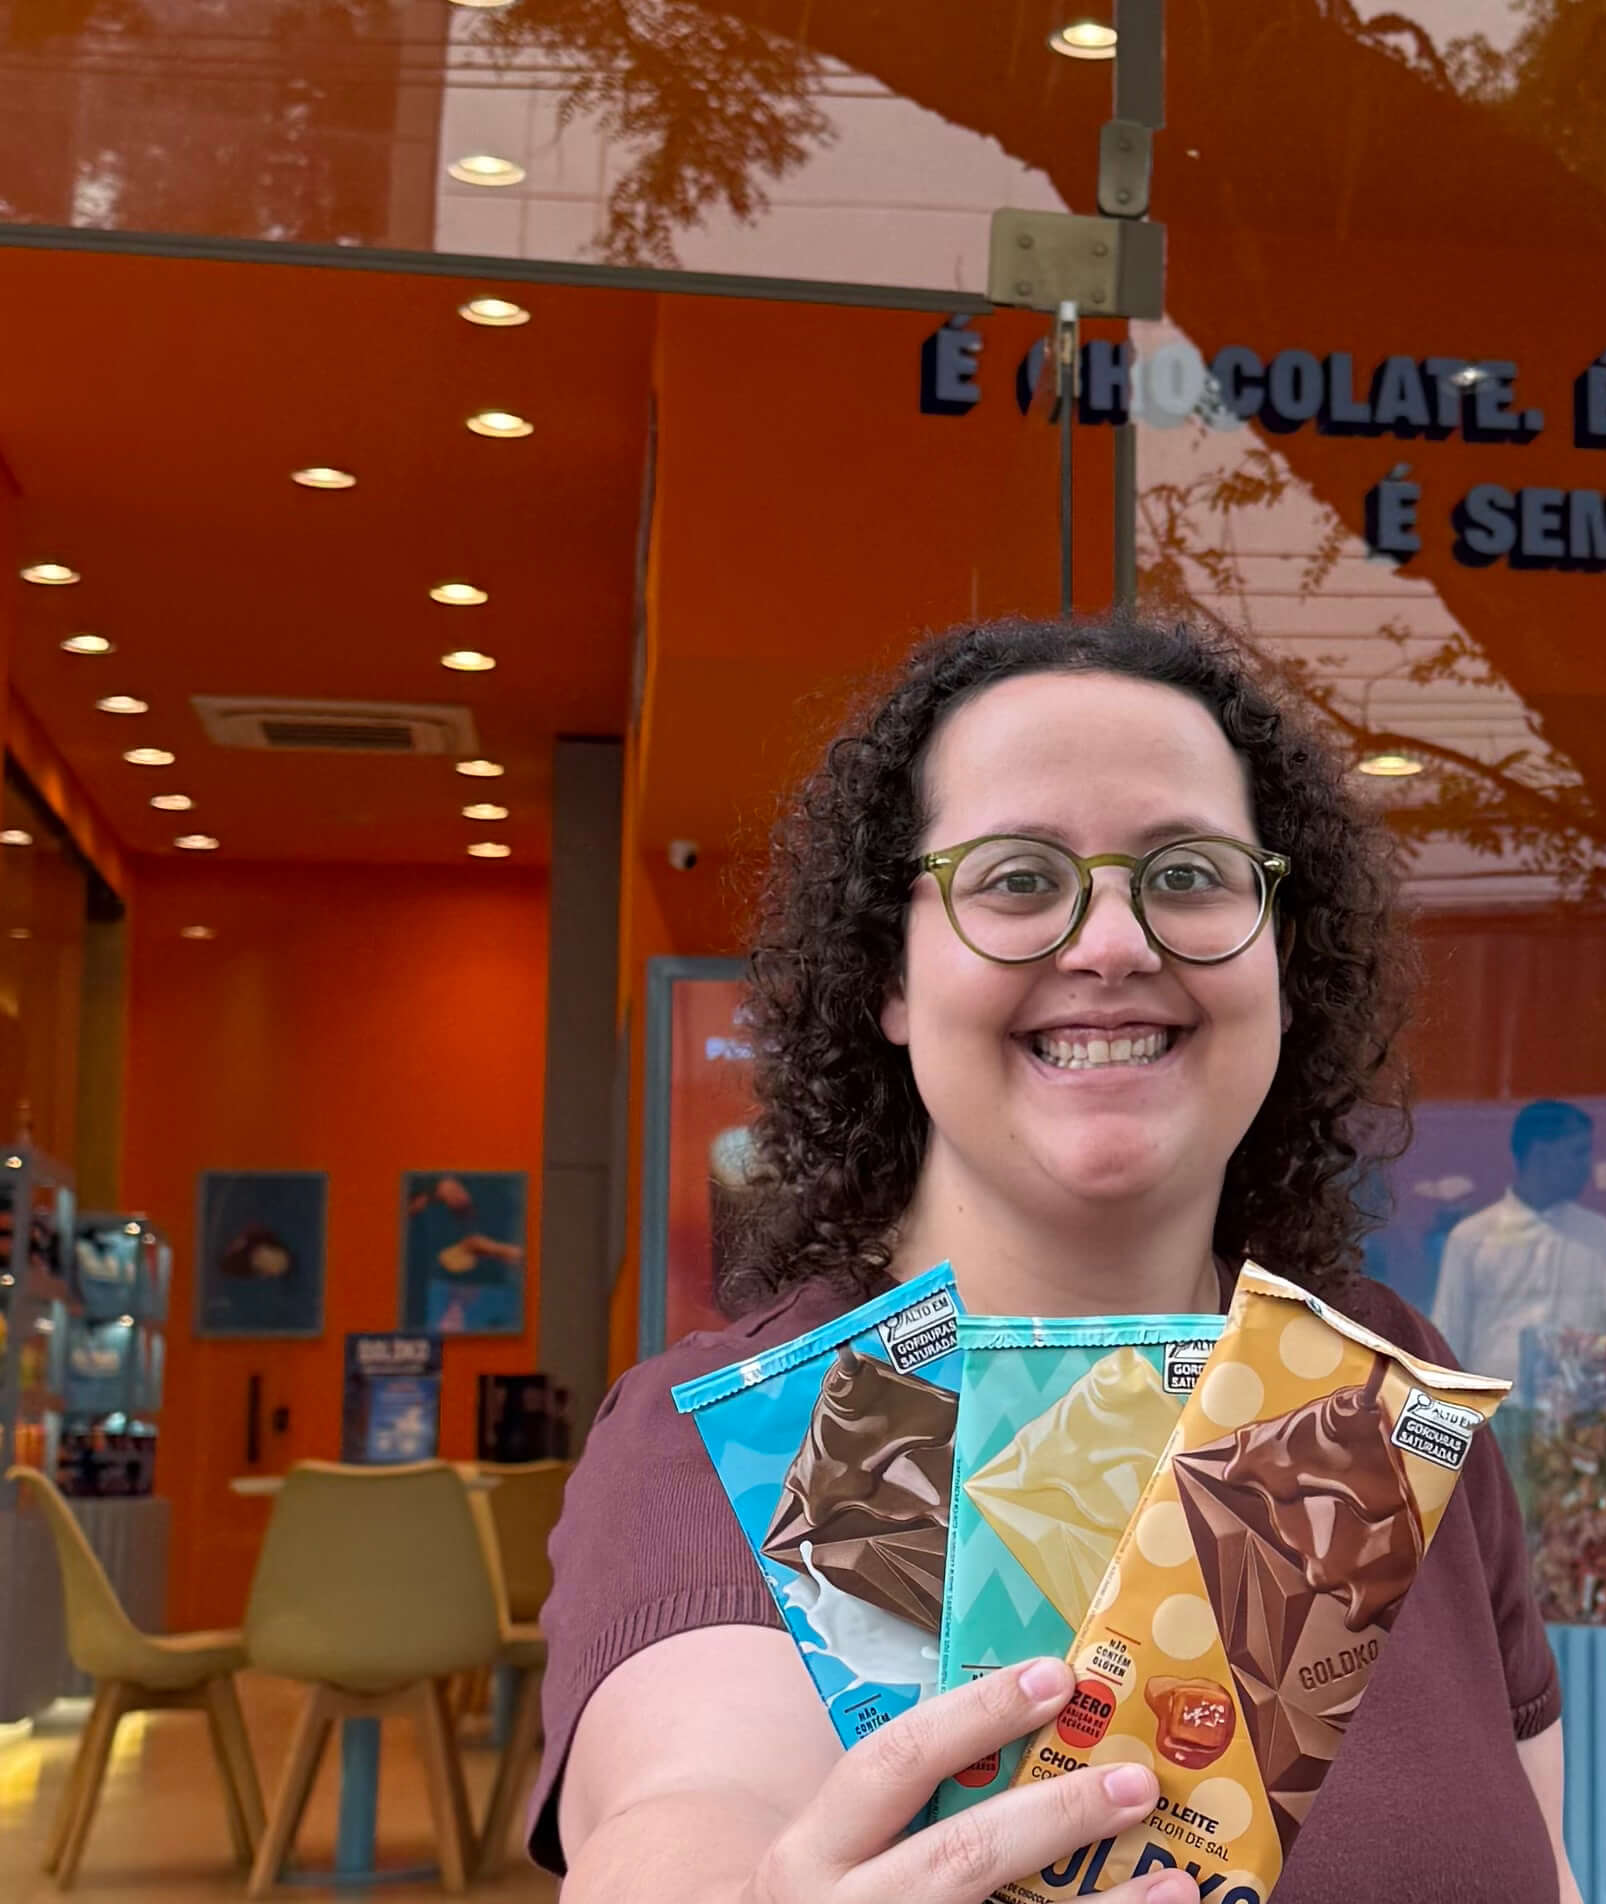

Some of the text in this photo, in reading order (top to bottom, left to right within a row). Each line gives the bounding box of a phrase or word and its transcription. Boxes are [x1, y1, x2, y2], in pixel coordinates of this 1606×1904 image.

[928, 313, 982, 407] É
[1370, 463, 1421, 557] É
[904, 1303, 932, 1326] ALTO
[897, 1320, 957, 1355] GORDURAS
[900, 1334, 957, 1368] SATURADA
[1299, 1639, 1379, 1691] GOLDKO
[1070, 1689, 1112, 1718] ZERO
[1170, 1802, 1219, 1834] LEITE
[1149, 1816, 1184, 1840] FLOR
[1185, 1831, 1205, 1849] DE
[1205, 1841, 1229, 1861] SAL
